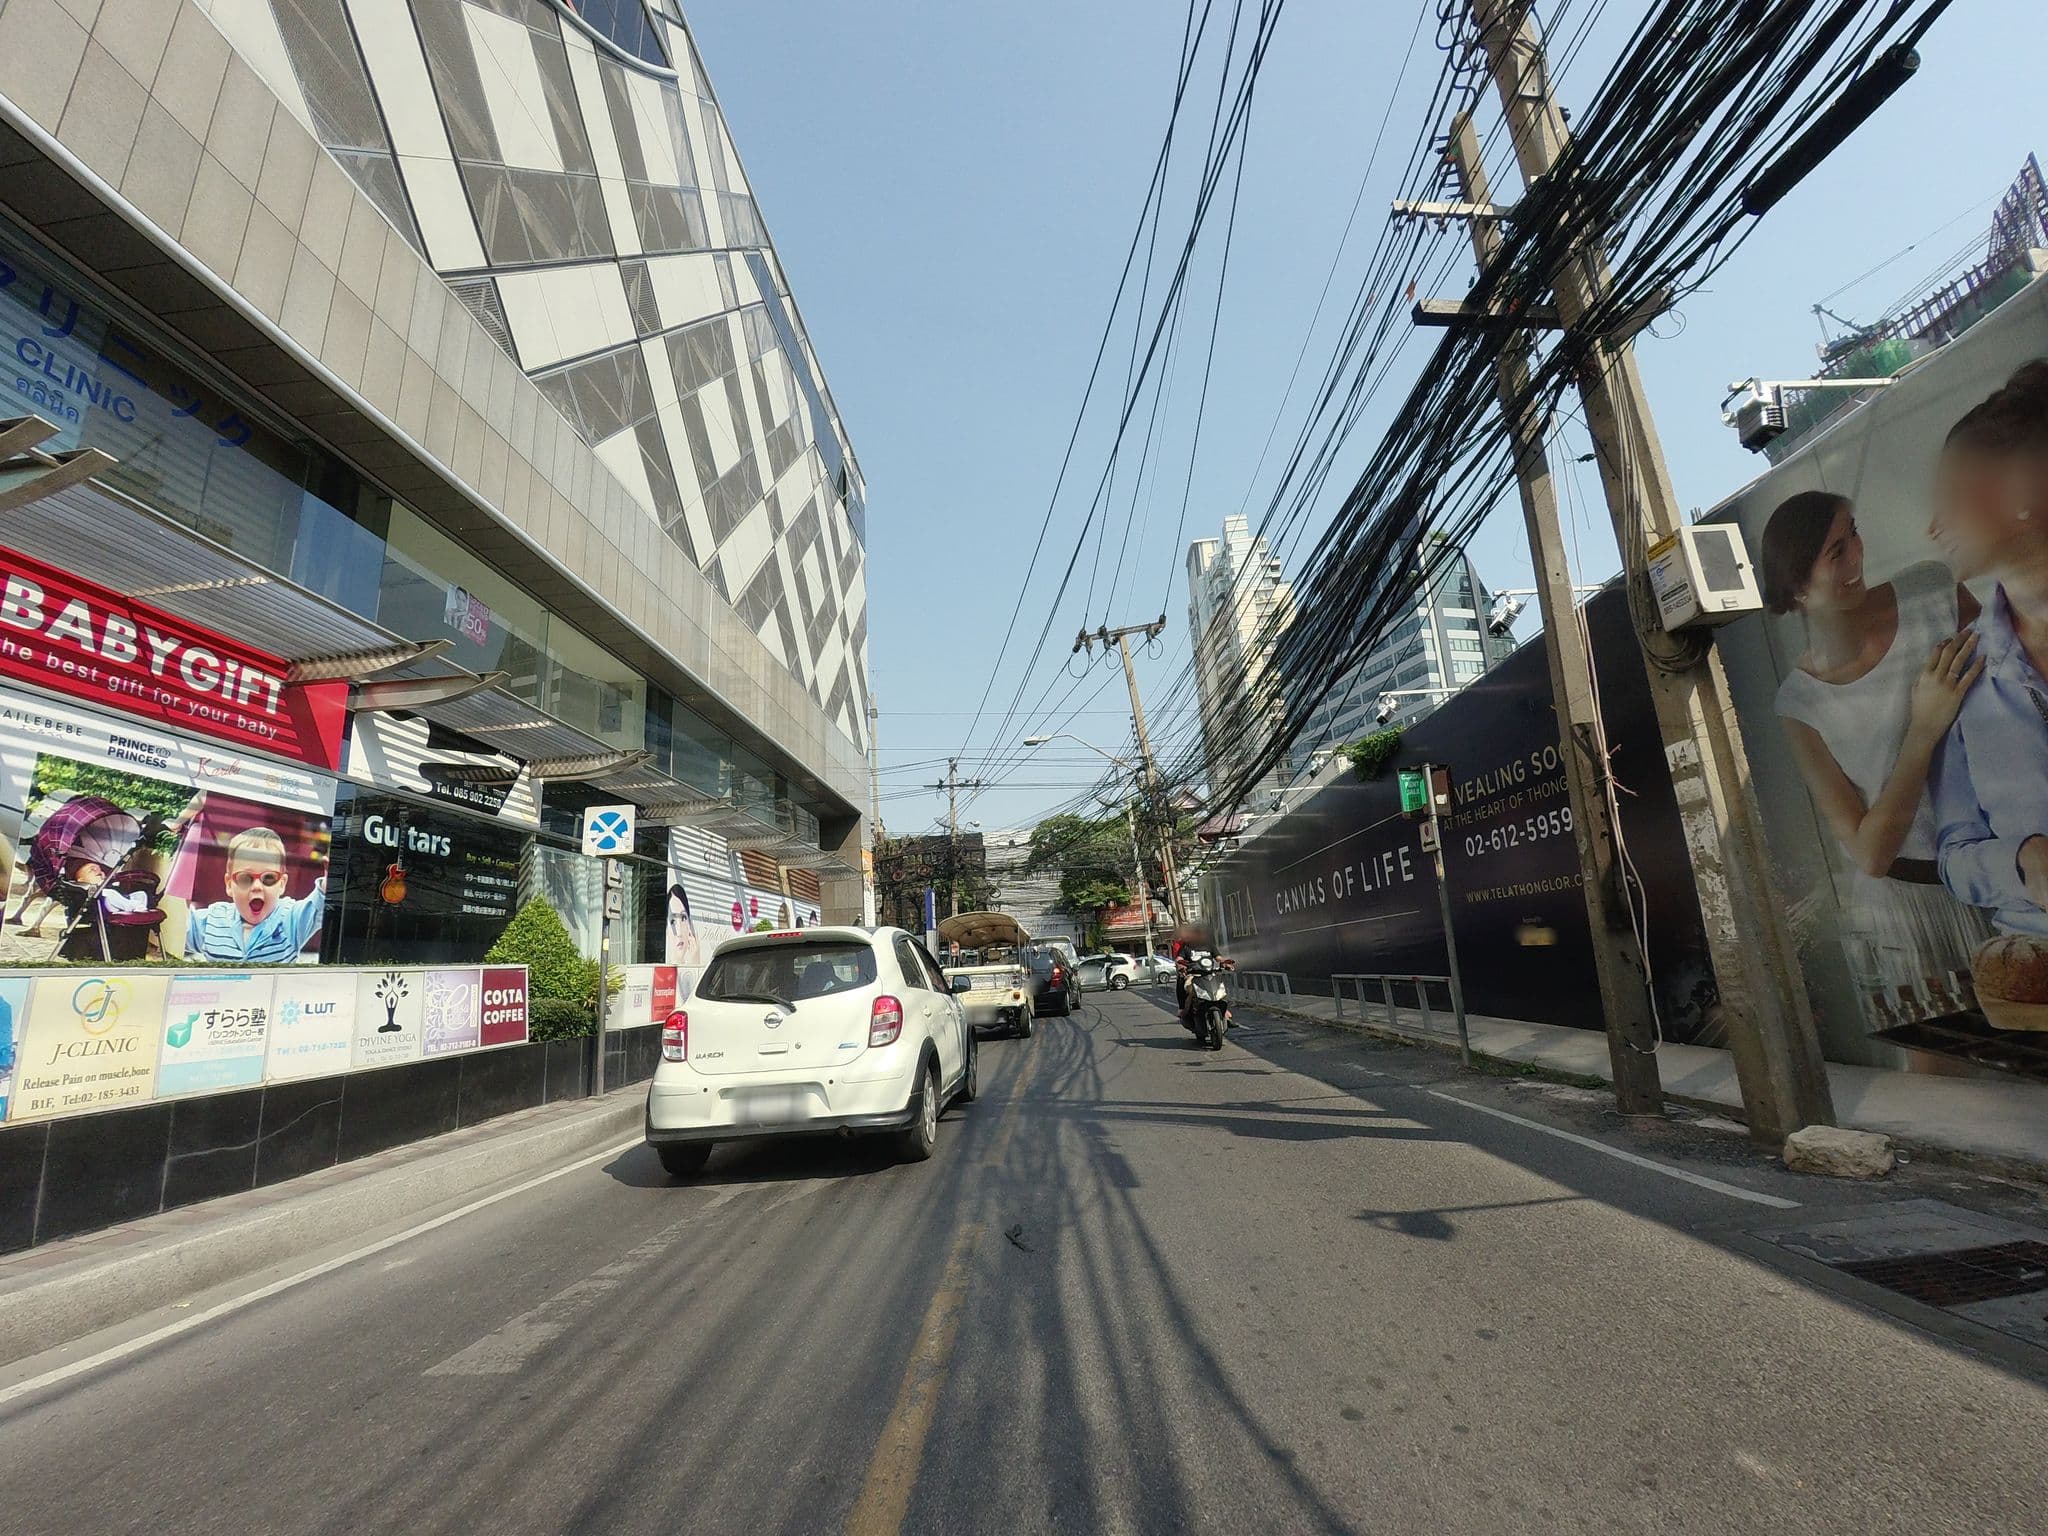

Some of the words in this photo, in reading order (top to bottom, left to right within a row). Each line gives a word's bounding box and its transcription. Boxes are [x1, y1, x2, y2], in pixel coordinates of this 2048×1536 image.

[16, 337, 136, 422] CLINIC
[46, 651, 98, 681] best
[108, 673, 145, 699] gift
[153, 687, 181, 707] for
[188, 701, 230, 723] your
[237, 715, 278, 740] baby
[3, 709, 83, 737] AILEBEBE
[109, 734, 156, 754] PRINCE
[107, 746, 168, 769] PRINCESS
[436, 781, 452, 796] Tel.
[1443, 817, 1455, 832] AT
[1455, 810, 1473, 827] THE
[1475, 798, 1507, 820] HEART
[1509, 791, 1524, 809] OF
[364, 815, 451, 857] Gutars
[1465, 806, 1573, 857] 02-612-5959
[1276, 876, 1326, 915] CANVAS
[1332, 866, 1354, 899] OF
[1360, 845, 1415, 892] LIFE
[304, 1002, 336, 1015] LWT
[484, 989, 524, 1006] COSTA
[484, 1008, 524, 1025] COFFEE
[46, 1037, 139, 1066] J-CLINIC
[360, 1035, 392, 1048] DIVINE
[394, 1033, 417, 1044] YOGA
[695, 1051, 724, 1060] MARCH
[22, 1078, 60, 1091] Release
[62, 1073, 83, 1086] Pain
[85, 1073, 97, 1083] on
